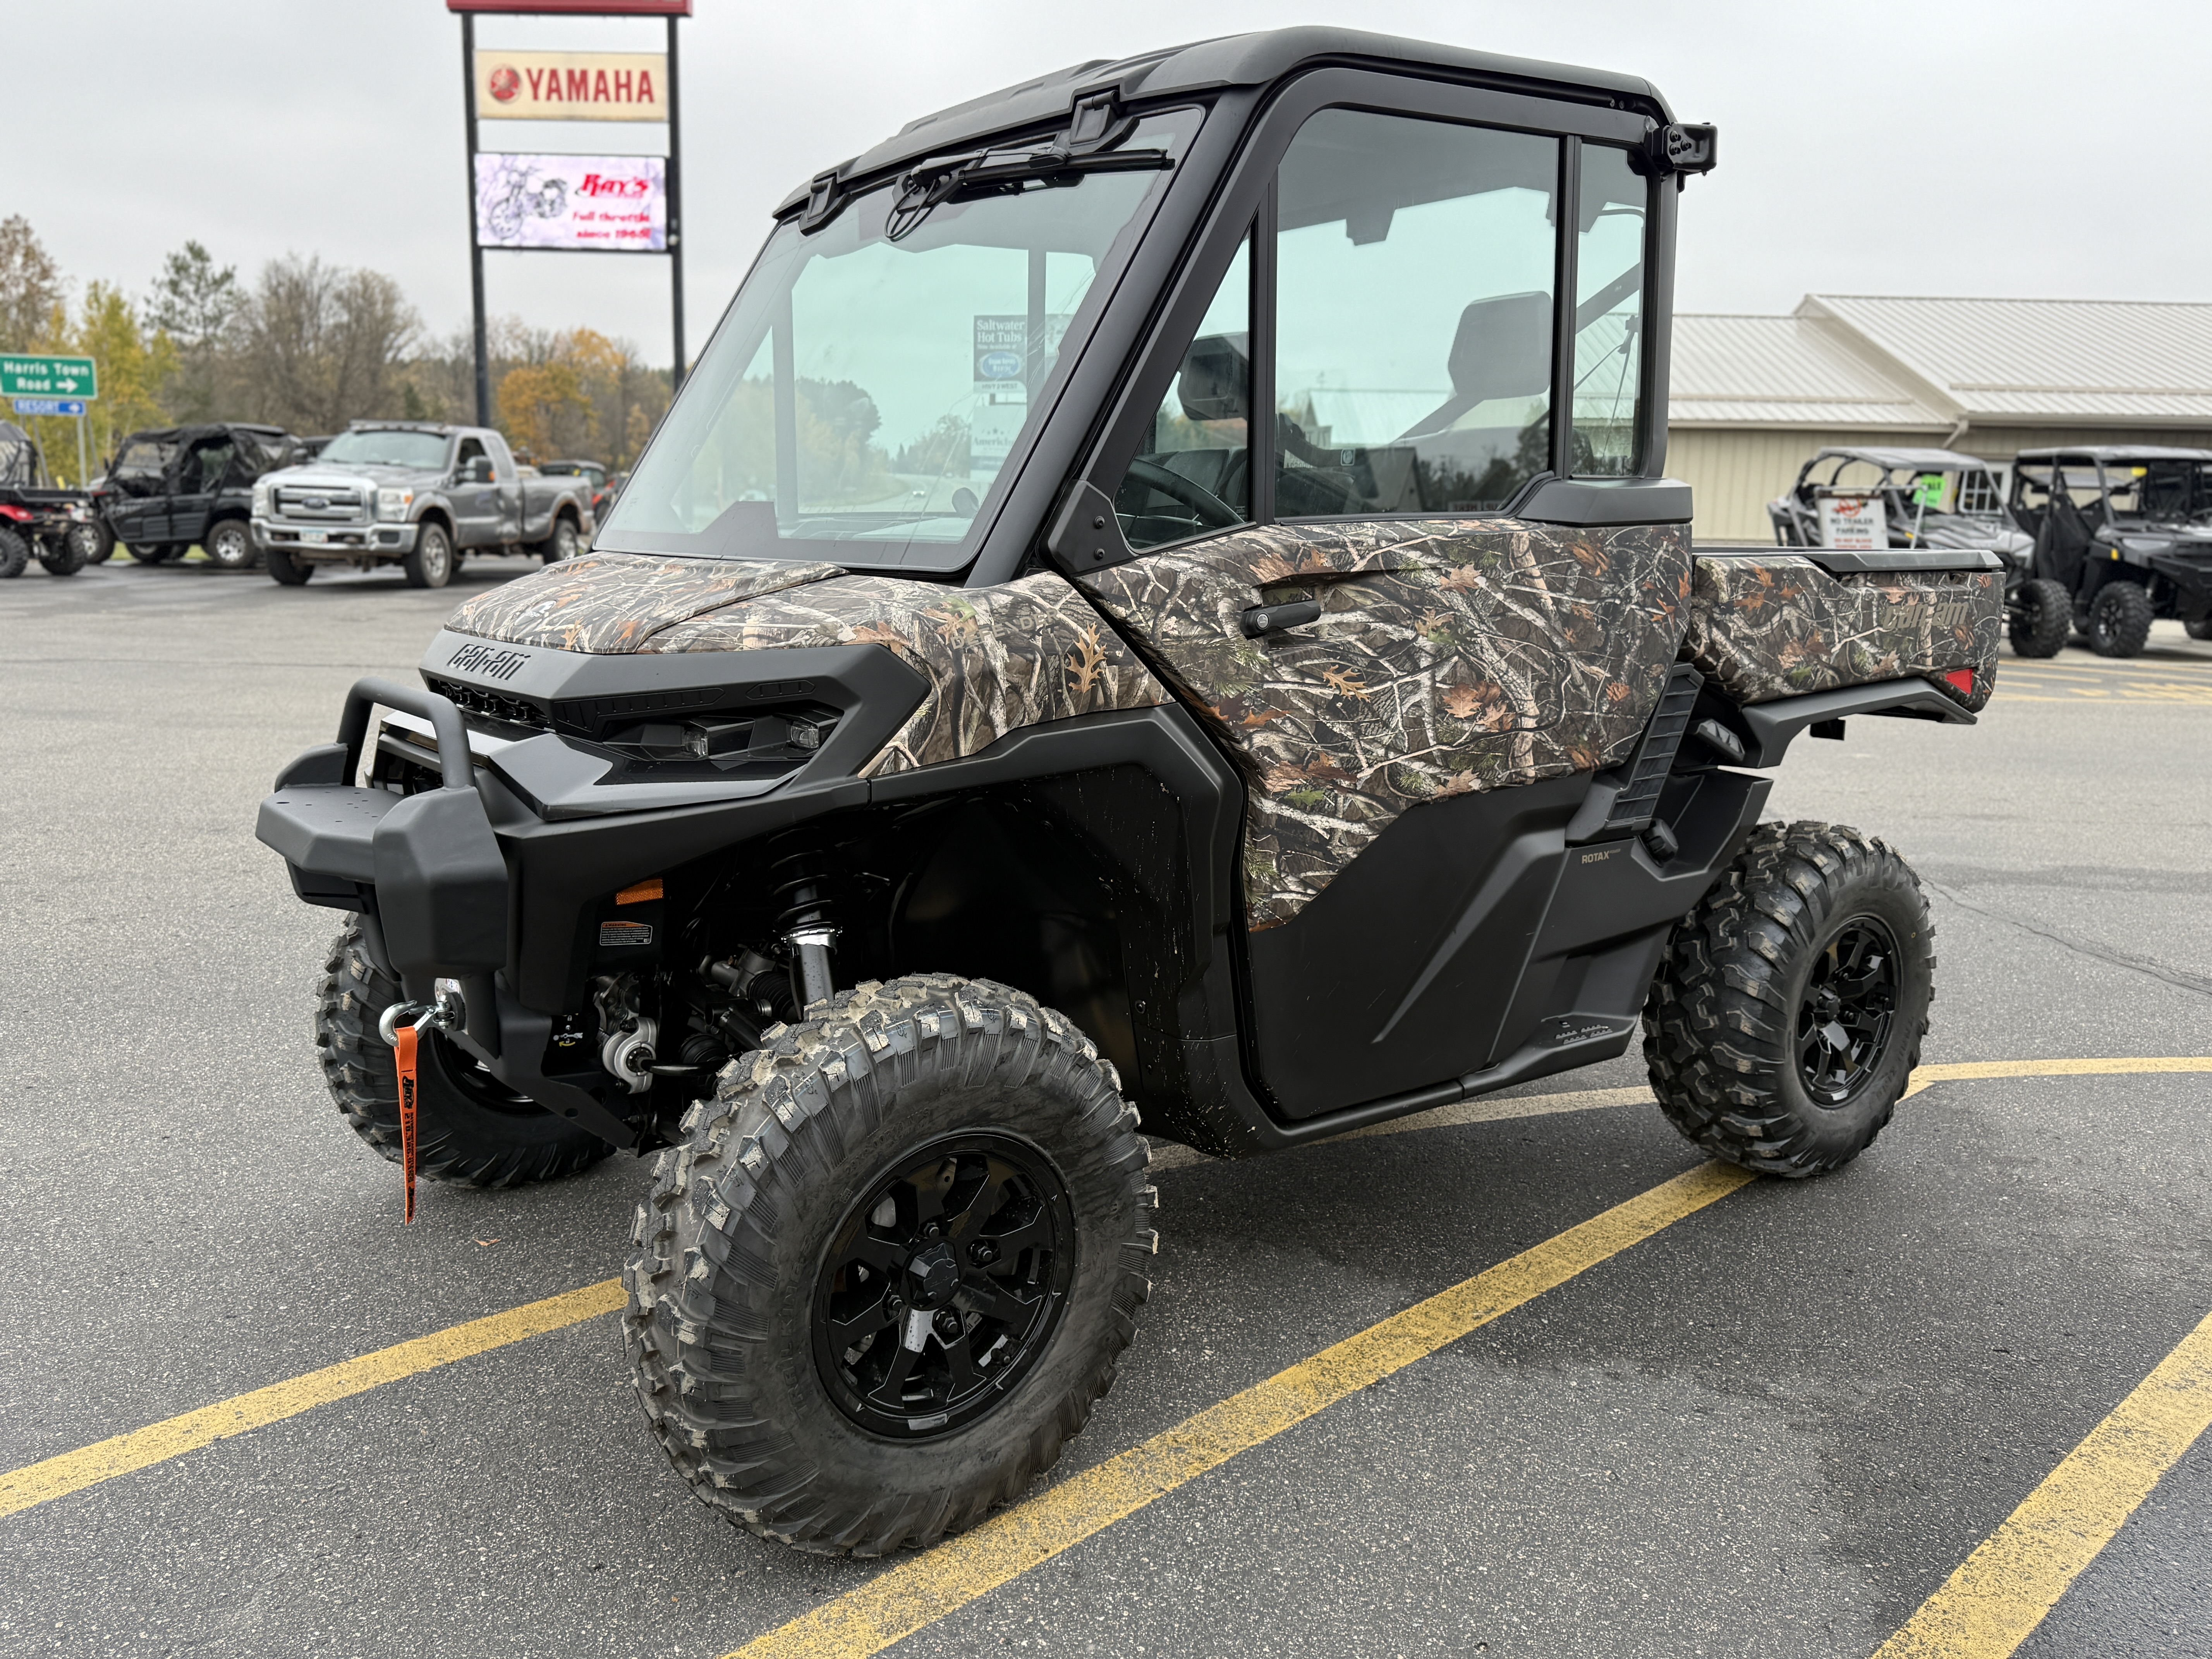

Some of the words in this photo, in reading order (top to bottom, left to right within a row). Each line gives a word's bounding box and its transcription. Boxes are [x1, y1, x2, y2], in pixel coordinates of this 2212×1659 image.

[526, 68, 654, 103] YAMAHA
[582, 174, 649, 197] Ray's
[577, 229, 610, 238] since
[977, 319, 1025, 331] Saltwater
[977, 331, 995, 343] Hot
[996, 331, 1022, 343] Tubs
[3, 361, 48, 376] Harris
[53, 362, 89, 377] Town
[16, 376, 51, 392] Road
[1882, 602, 1969, 630] can-am
[446, 643, 531, 680] can-am
[1581, 850, 1609, 864] ROTAX
